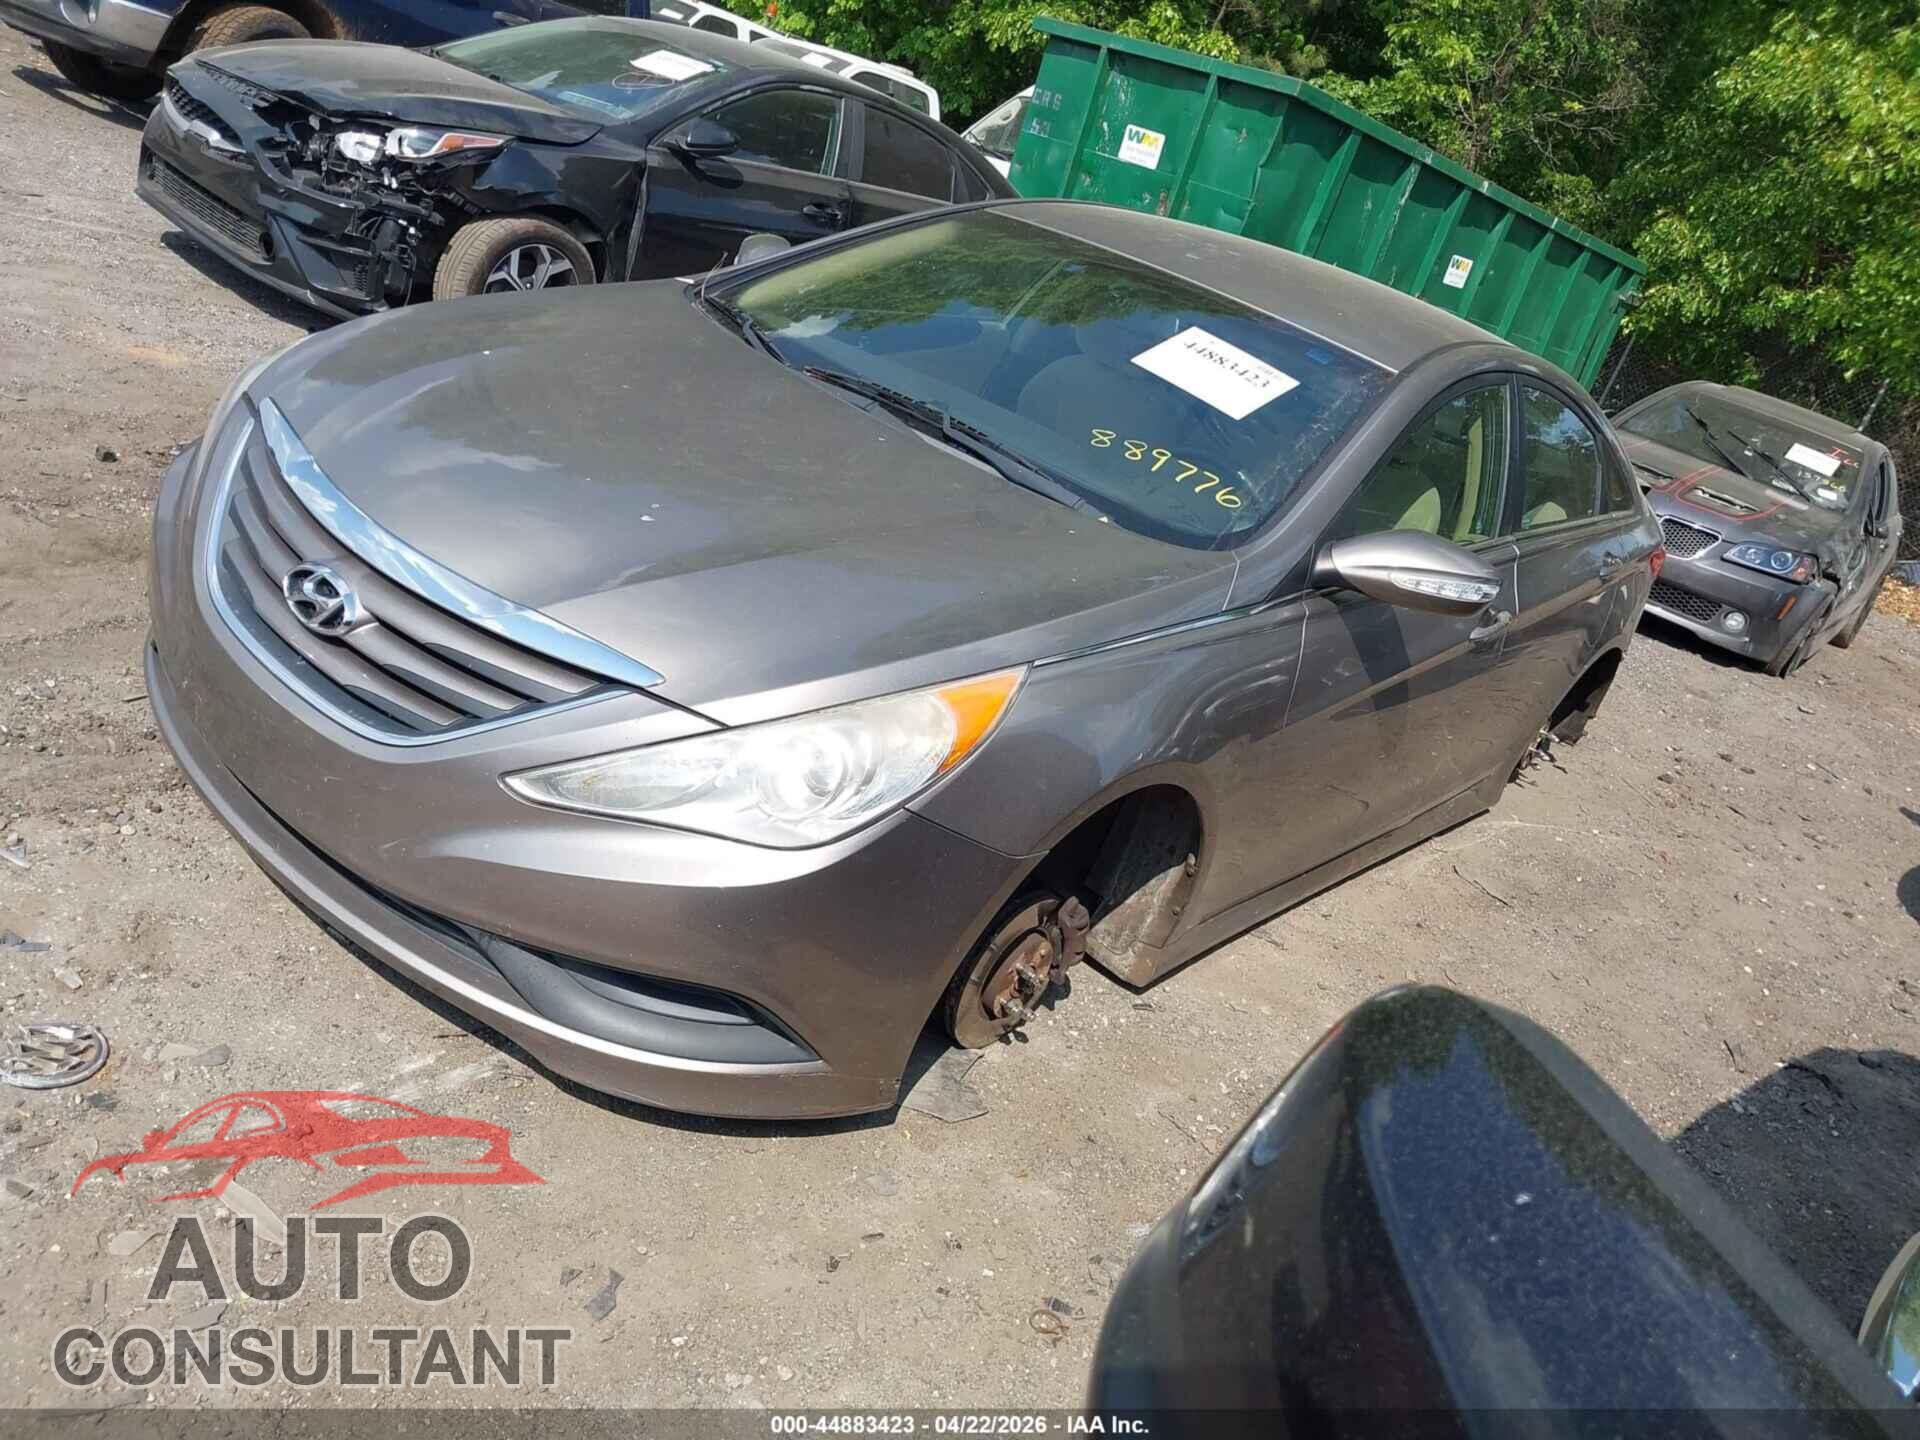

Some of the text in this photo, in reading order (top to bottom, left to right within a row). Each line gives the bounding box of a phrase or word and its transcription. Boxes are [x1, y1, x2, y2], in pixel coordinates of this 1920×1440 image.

[1127, 127, 1160, 151] WM
[1183, 341, 1271, 389] 44883423
[1090, 428, 1242, 508] 889776
